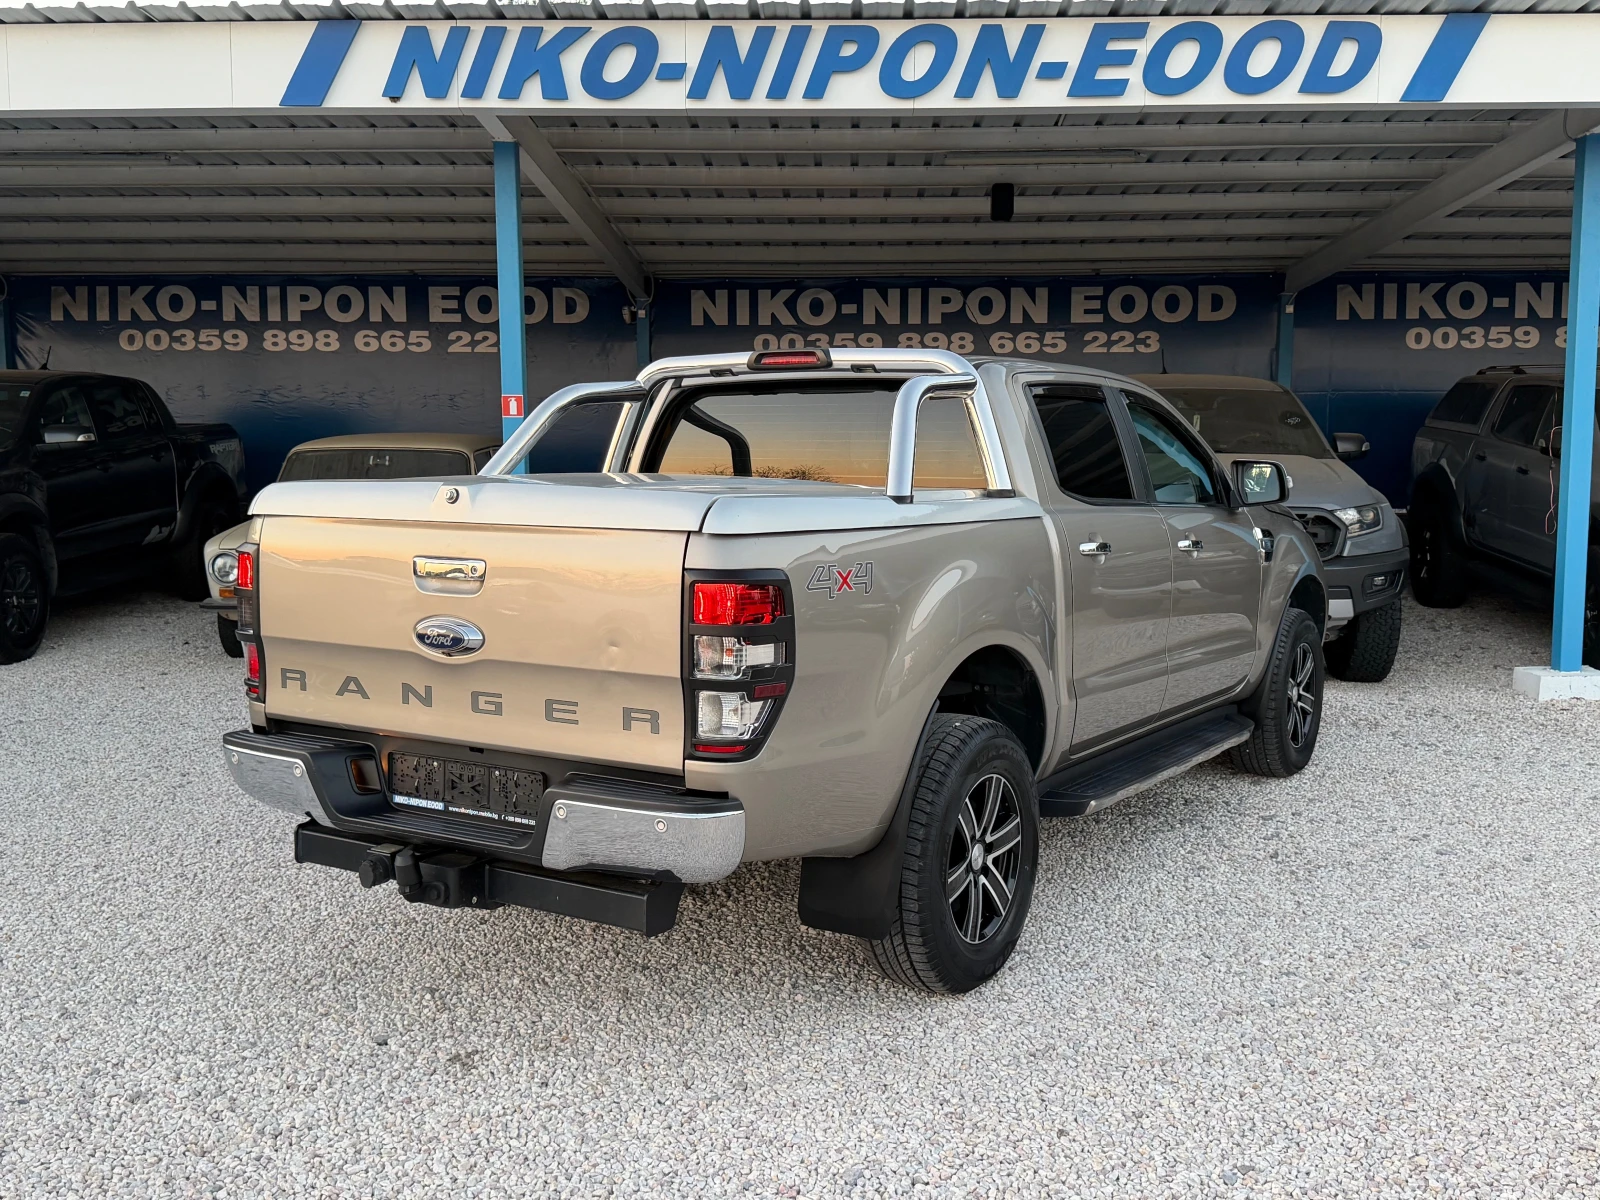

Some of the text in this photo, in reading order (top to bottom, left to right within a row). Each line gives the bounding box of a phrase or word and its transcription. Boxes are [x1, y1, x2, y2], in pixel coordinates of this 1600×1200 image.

[382, 20, 1383, 101] NIKO-NIPON-EOOD
[51, 284, 590, 325] NIKO-NIPON EOOD
[690, 285, 1237, 326] NIKO-NIPON EOOD
[118, 329, 499, 353] 00359 898 665 22
[753, 331, 1161, 354] 00359 898 665 223
[1405, 325, 1541, 350] 00359
[424, 627, 454, 646] Ford
[280, 667, 661, 735] RANGER
